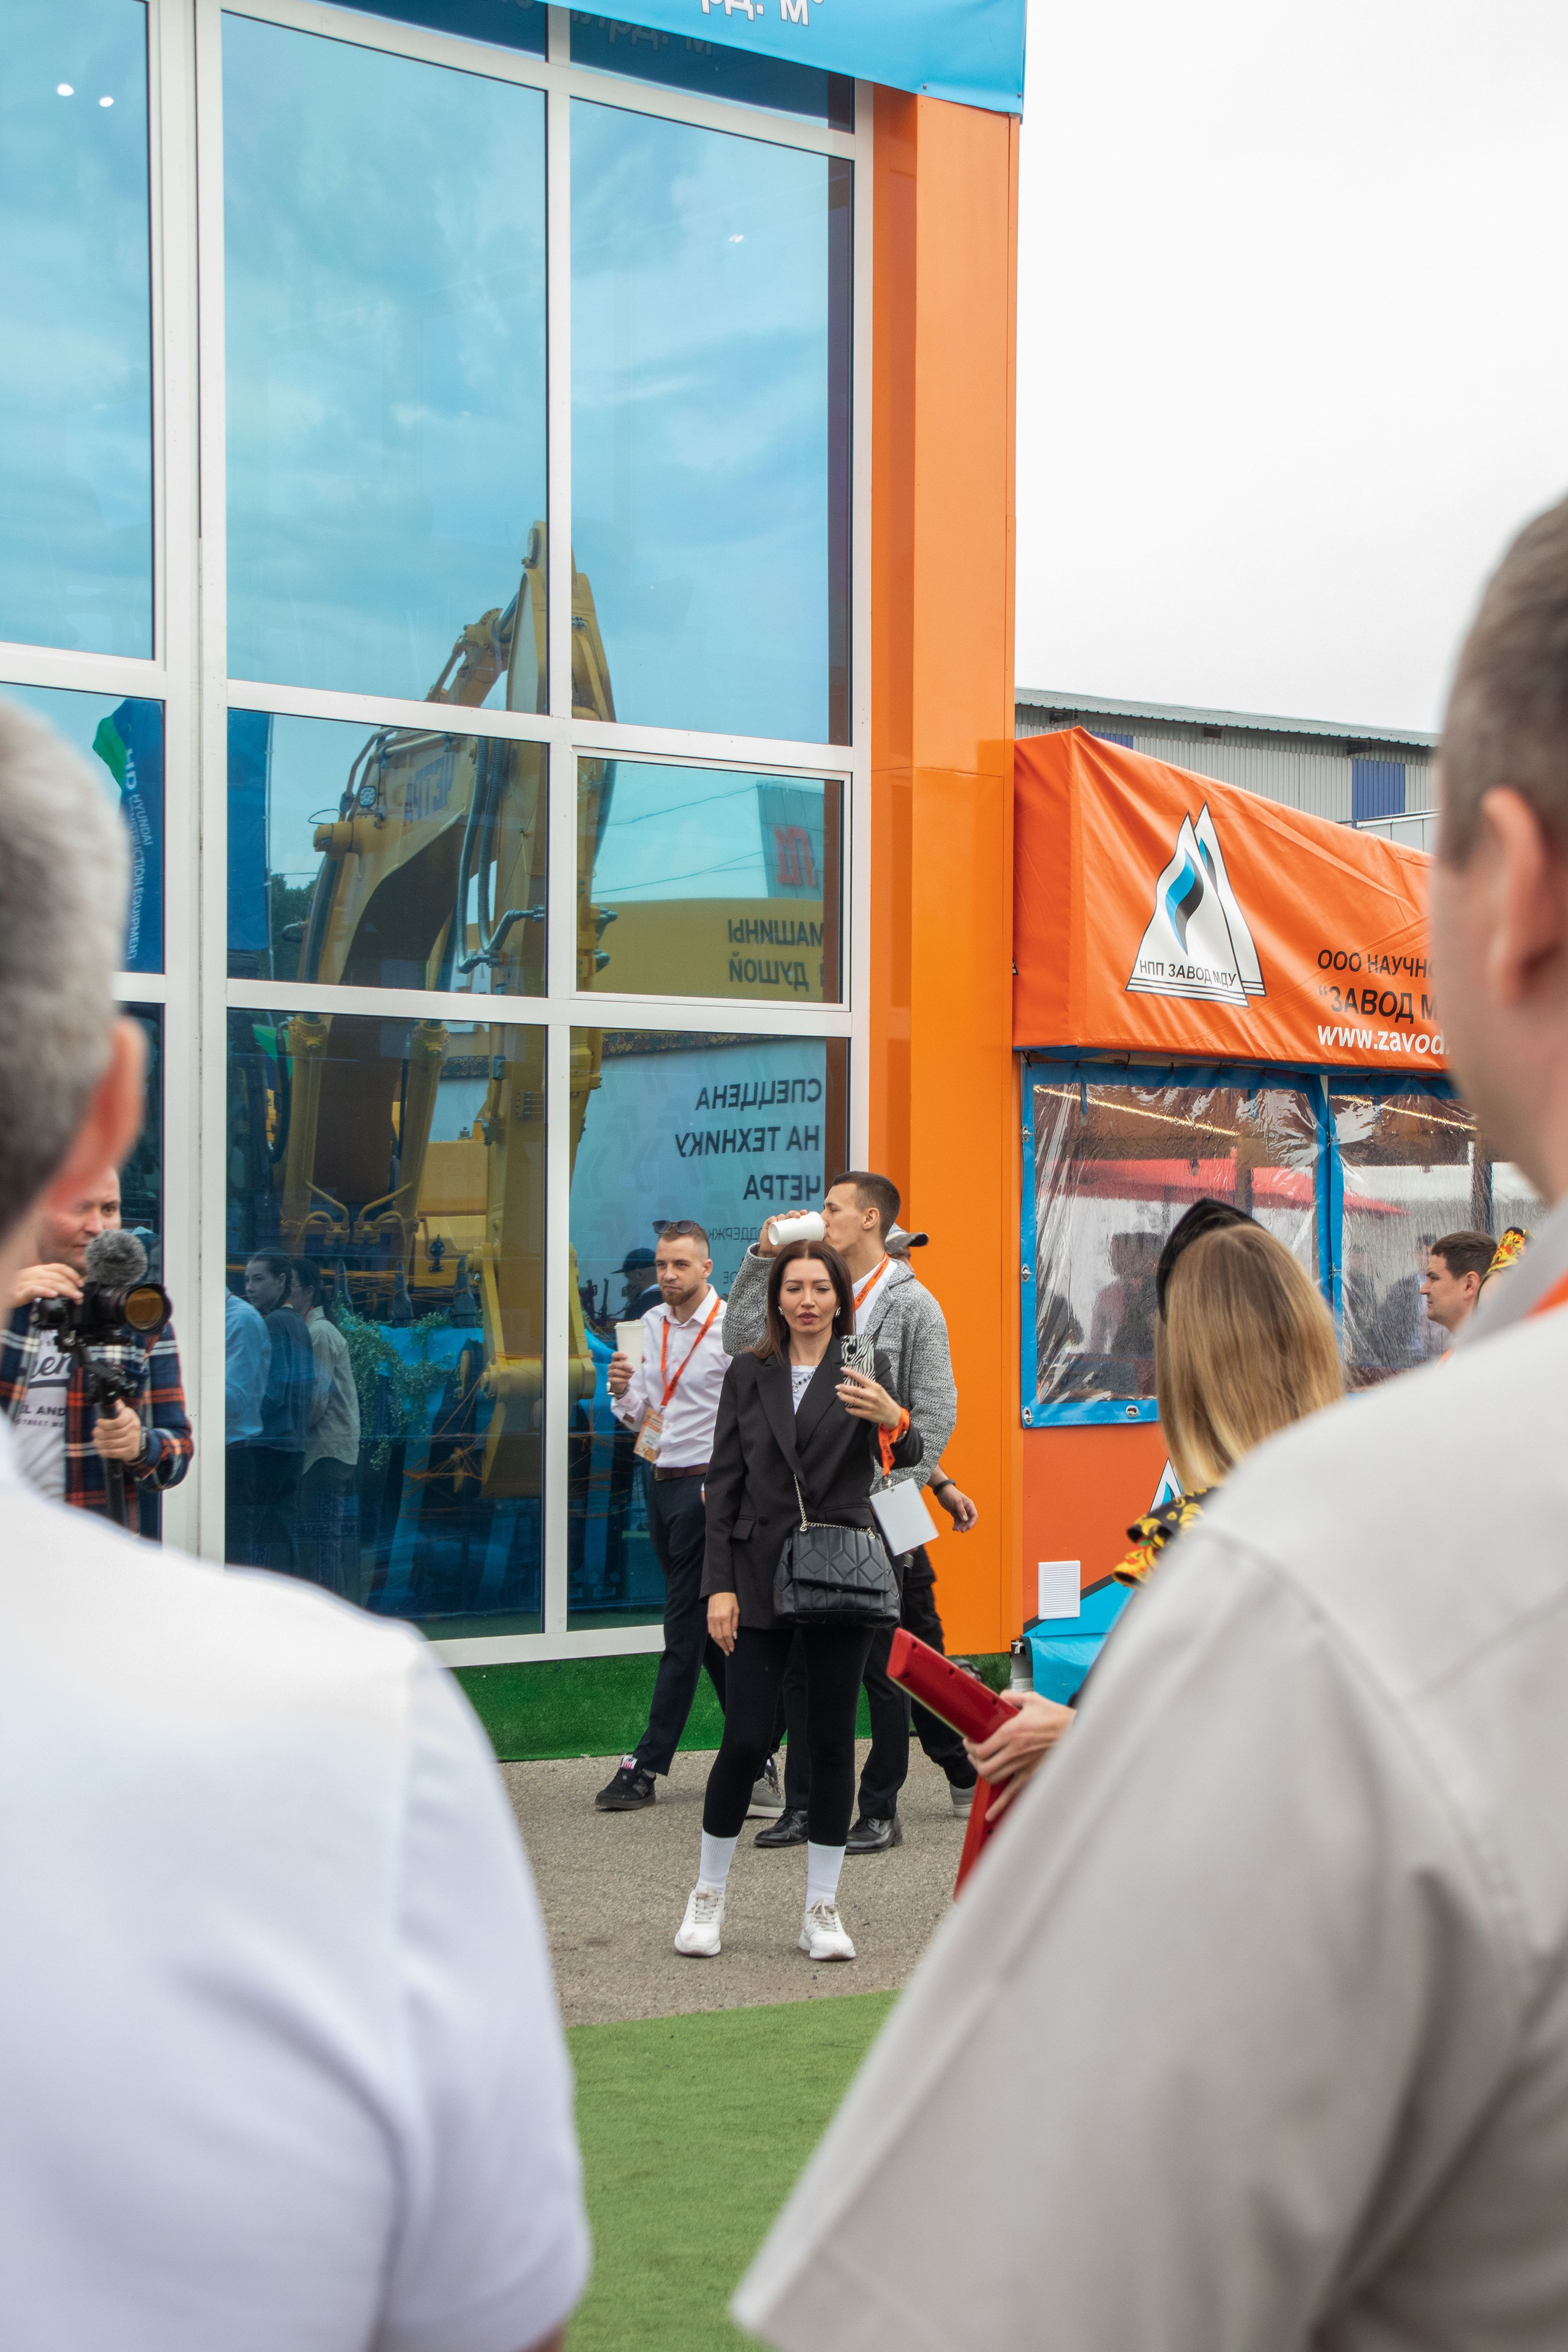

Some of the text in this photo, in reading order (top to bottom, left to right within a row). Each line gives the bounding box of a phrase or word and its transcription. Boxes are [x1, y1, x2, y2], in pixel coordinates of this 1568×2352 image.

[133, 794, 153, 845] HYUNDAI
[127, 888, 144, 960] EQUIPMENT
[1140, 960, 1237, 988] НПП ЗАВОД МДУ
[1317, 949, 1362, 972] ООО
